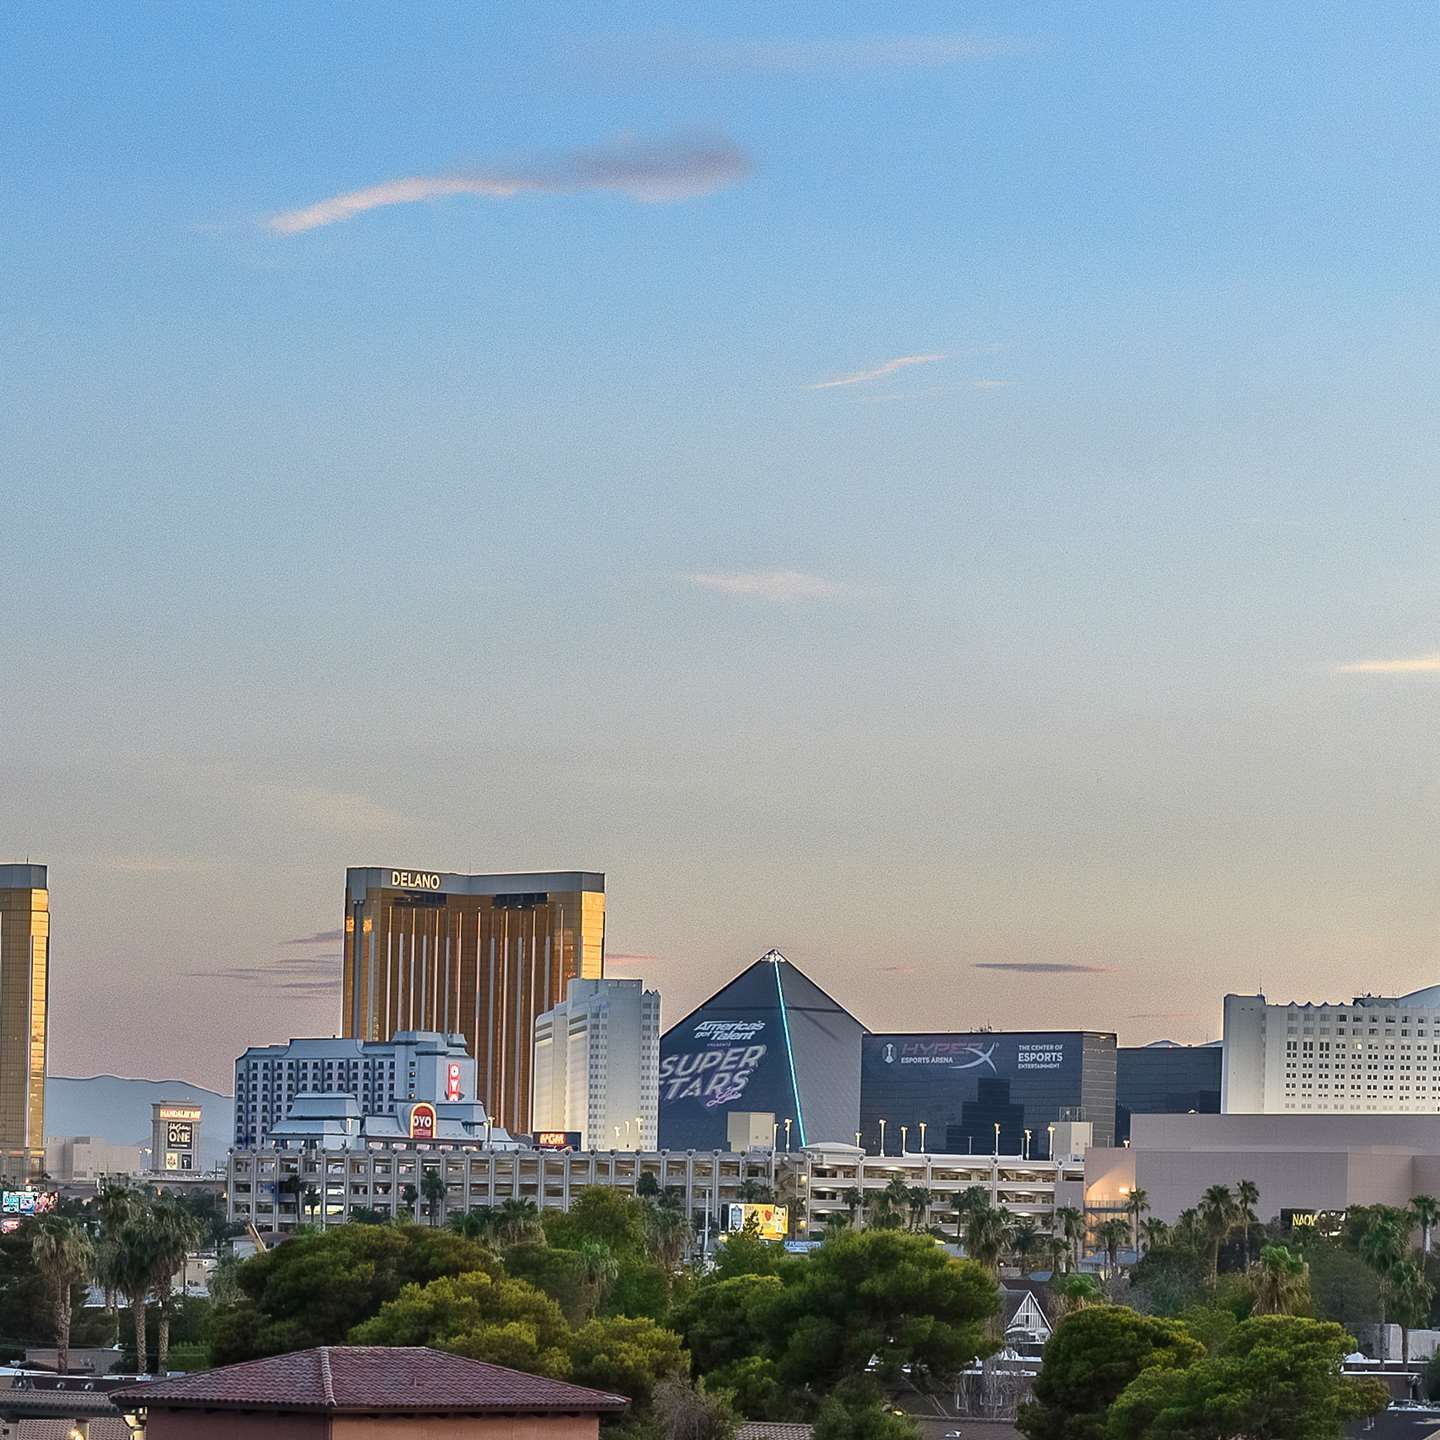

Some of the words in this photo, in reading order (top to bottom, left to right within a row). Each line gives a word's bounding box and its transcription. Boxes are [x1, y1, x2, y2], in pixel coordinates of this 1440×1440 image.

[392, 871, 440, 889] DELANO
[710, 1031, 756, 1041] Talent
[659, 1044, 767, 1078] SUPER
[1018, 1052, 1063, 1062] ESPORTS
[659, 1069, 754, 1100] TARS
[413, 1116, 432, 1127] OYO
[168, 1131, 191, 1142] ONE
